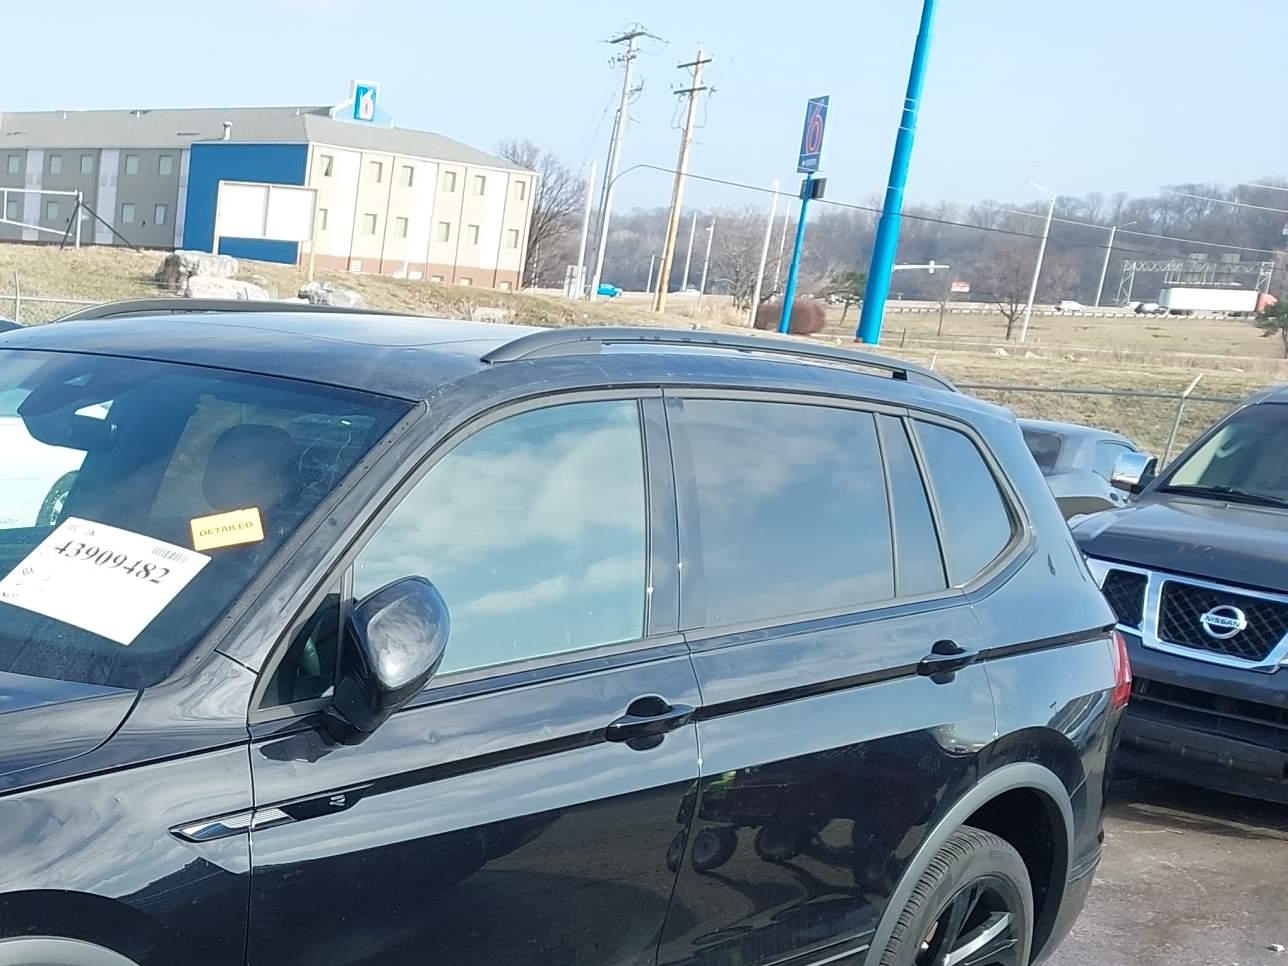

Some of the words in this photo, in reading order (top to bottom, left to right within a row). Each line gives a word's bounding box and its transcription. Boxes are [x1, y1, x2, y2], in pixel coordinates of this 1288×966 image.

[359, 87, 374, 120] 6
[805, 98, 824, 155] 6
[198, 520, 254, 537] DETAILED
[54, 540, 170, 584] 43909482
[1204, 615, 1241, 628] NISSAN
